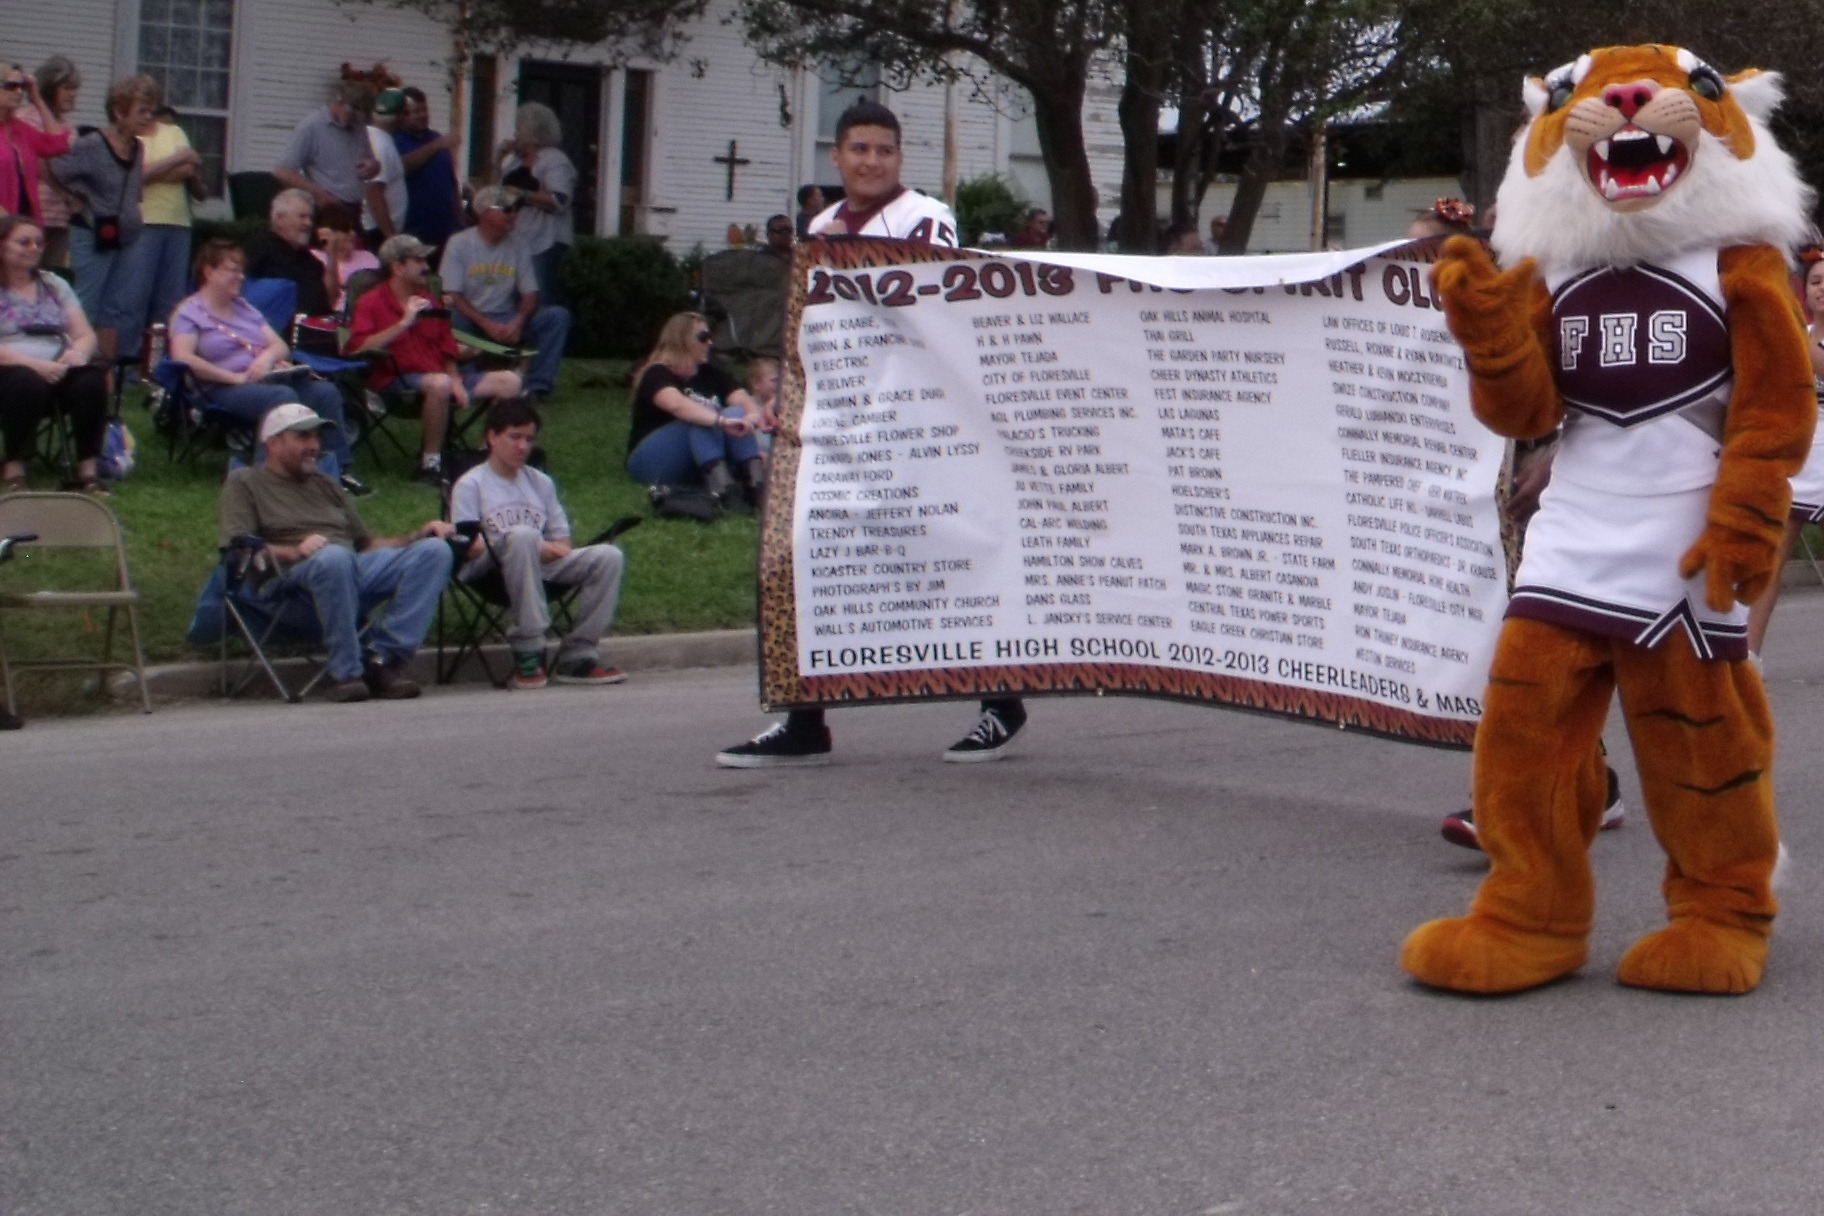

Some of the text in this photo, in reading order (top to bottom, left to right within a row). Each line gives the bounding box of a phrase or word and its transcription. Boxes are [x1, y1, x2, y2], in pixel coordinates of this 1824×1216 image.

[973, 312, 1090, 328] BEAVER & LIZ WALLACE
[1140, 310, 1271, 324] OAK HILLS ANIMAL HOSPITAL
[1323, 316, 1387, 333] LAW OFFICES OF
[977, 332, 1042, 347] H & H PAWN
[1561, 311, 1686, 370] FHS
[980, 351, 1058, 366] MAYOR TEJADA
[1148, 349, 1285, 365] THE GARDEN PARTY NURSERY
[1329, 360, 1364, 375] HEATHER
[983, 369, 1090, 385] CITY OF FLORESVILLE
[1151, 369, 1278, 384] CHEER DYNASTY ATHLETICS
[879, 389, 915, 403] GRACE
[986, 387, 1128, 404] FLORESVILLE EVENT CENTER
[1182, 389, 1232, 402] INSURANCE
[1237, 390, 1271, 404] AGENCY
[1015, 408, 1067, 422] PLUMBING
[1071, 407, 1115, 419] SERVICES
[1158, 408, 1175, 420] LAS
[878, 425, 959, 442] FLOWER SHOP
[1051, 426, 1100, 437] TRUCKING
[1199, 428, 1221, 441] CAFE
[857, 443, 980, 463] JONES ALVIN LYSSY
[1059, 444, 1101, 456] RV PARK
[1199, 448, 1221, 460] CAFE
[864, 470, 893, 481] FORD
[1040, 463, 1129, 476] & GLORIA ALBERT
[1168, 466, 1222, 480] PAT BROWN
[1344, 469, 1359, 483] THE
[810, 487, 919, 502] COSMIC CREATIONS
[1060, 481, 1094, 494] FAMILY
[866, 503, 958, 519] JEFFERY NOLAN
[1018, 499, 1108, 512] JOHN ALBERT
[1175, 503, 1297, 526] DISTINCTIVE CONSTRUCTION
[810, 525, 926, 540] TRENDY TREASURES
[1179, 523, 1323, 548] SOUTH TEXAS APPLIANCES REPAIR
[1022, 537, 1090, 548] LEATH FAMILY
[810, 546, 839, 559] LAZY
[844, 546, 850, 556] J
[1181, 542, 1335, 570] MARK BROWN STATE FARM
[812, 560, 972, 578] KICASTER COUNTRY STORE
[1024, 555, 1143, 570] HAMILTON SHOW CALVES
[1204, 564, 1210, 575] &
[1240, 569, 1271, 582] ALBERT
[907, 581, 920, 592] BY
[928, 579, 945, 591] JIM
[1099, 575, 1133, 587] PEANUT
[1060, 594, 1091, 605] GLASS
[1217, 584, 1243, 598] STONE
[1248, 589, 1282, 604] GRANITE
[1288, 593, 1294, 605] &
[814, 595, 1000, 617] OAK HILLS COMMUNITY CHURCH
[1096, 613, 1172, 628] SERVICE CENTER
[1189, 601, 1325, 629] CENTRAL TEXAS POWER SPORTS
[861, 619, 933, 633] AUTOMOTIVE
[940, 615, 993, 629] SERVICES
[1191, 620, 1324, 649] EAGLE CREEK CHRISTIAN STORE
[810, 641, 983, 669] FLORESVILLE
[996, 637, 1058, 659] HIGH
[1070, 637, 1160, 659] SCHOOL
[1168, 642, 1269, 674] 2012-2013
[1278, 659, 1410, 704] CHEERLEADERS
[1416, 689, 1429, 707] &
